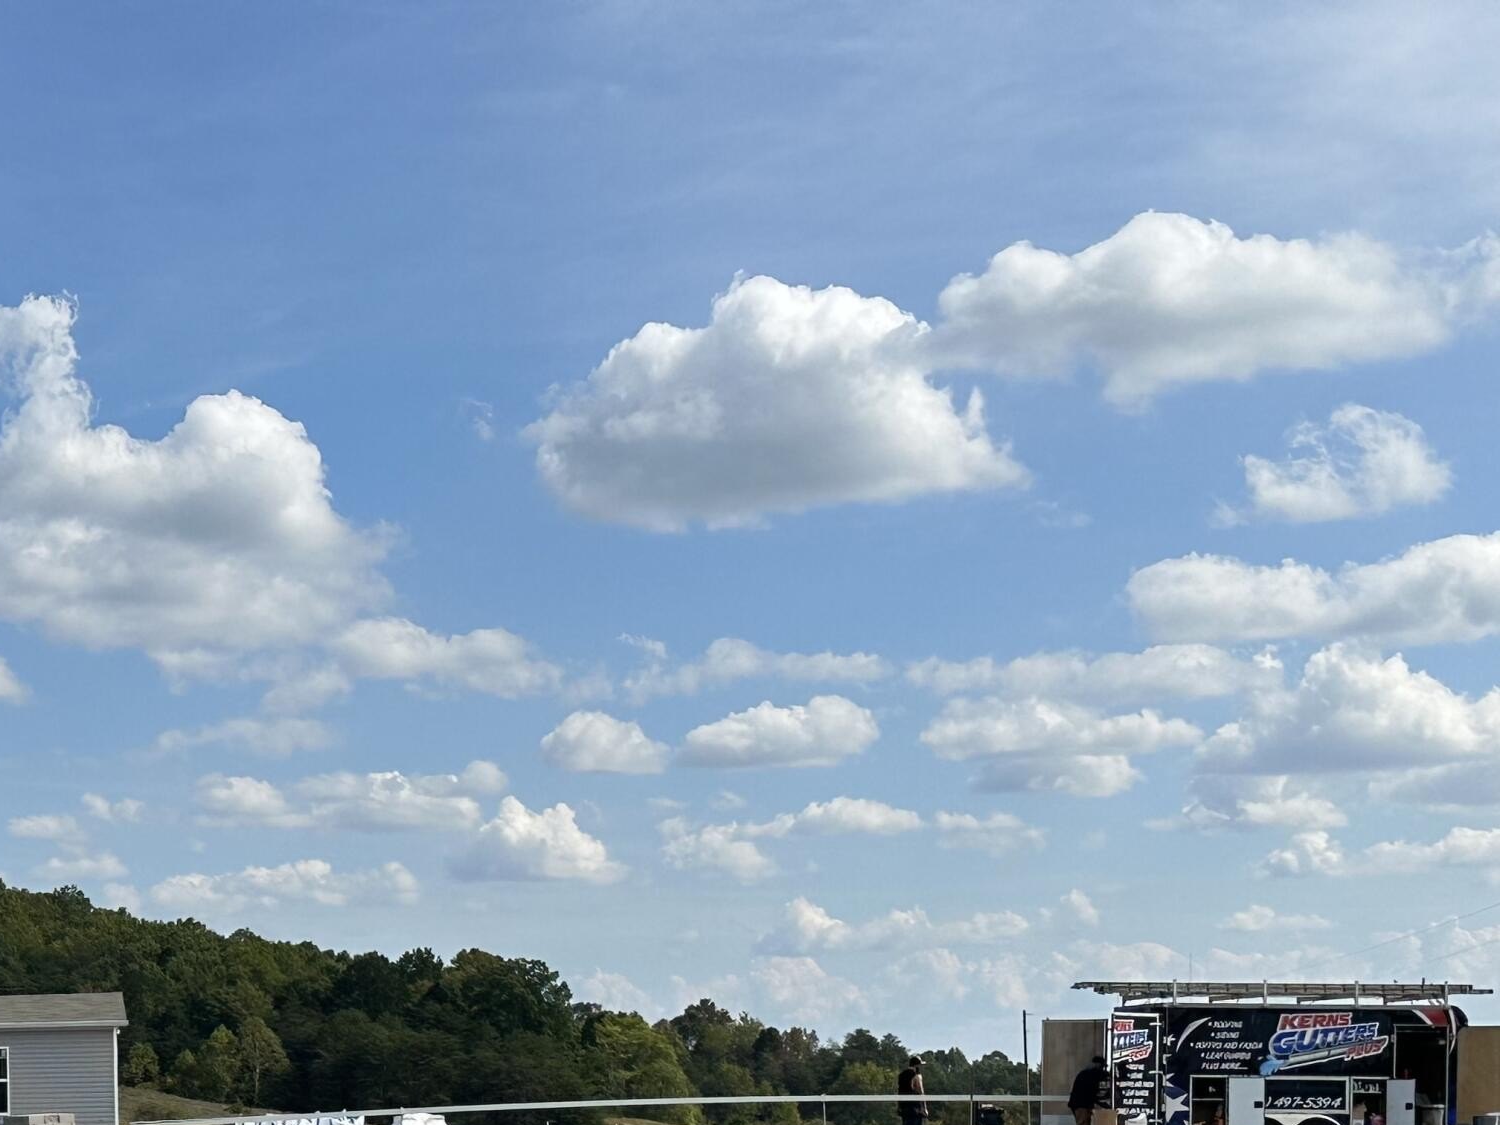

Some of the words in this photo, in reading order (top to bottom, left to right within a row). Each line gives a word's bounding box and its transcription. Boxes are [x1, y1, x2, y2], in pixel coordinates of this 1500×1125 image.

[1278, 1013, 1352, 1031] KERNS
[1270, 1023, 1379, 1055] GUTTERS
[1273, 1096, 1342, 1109] 497-5394
